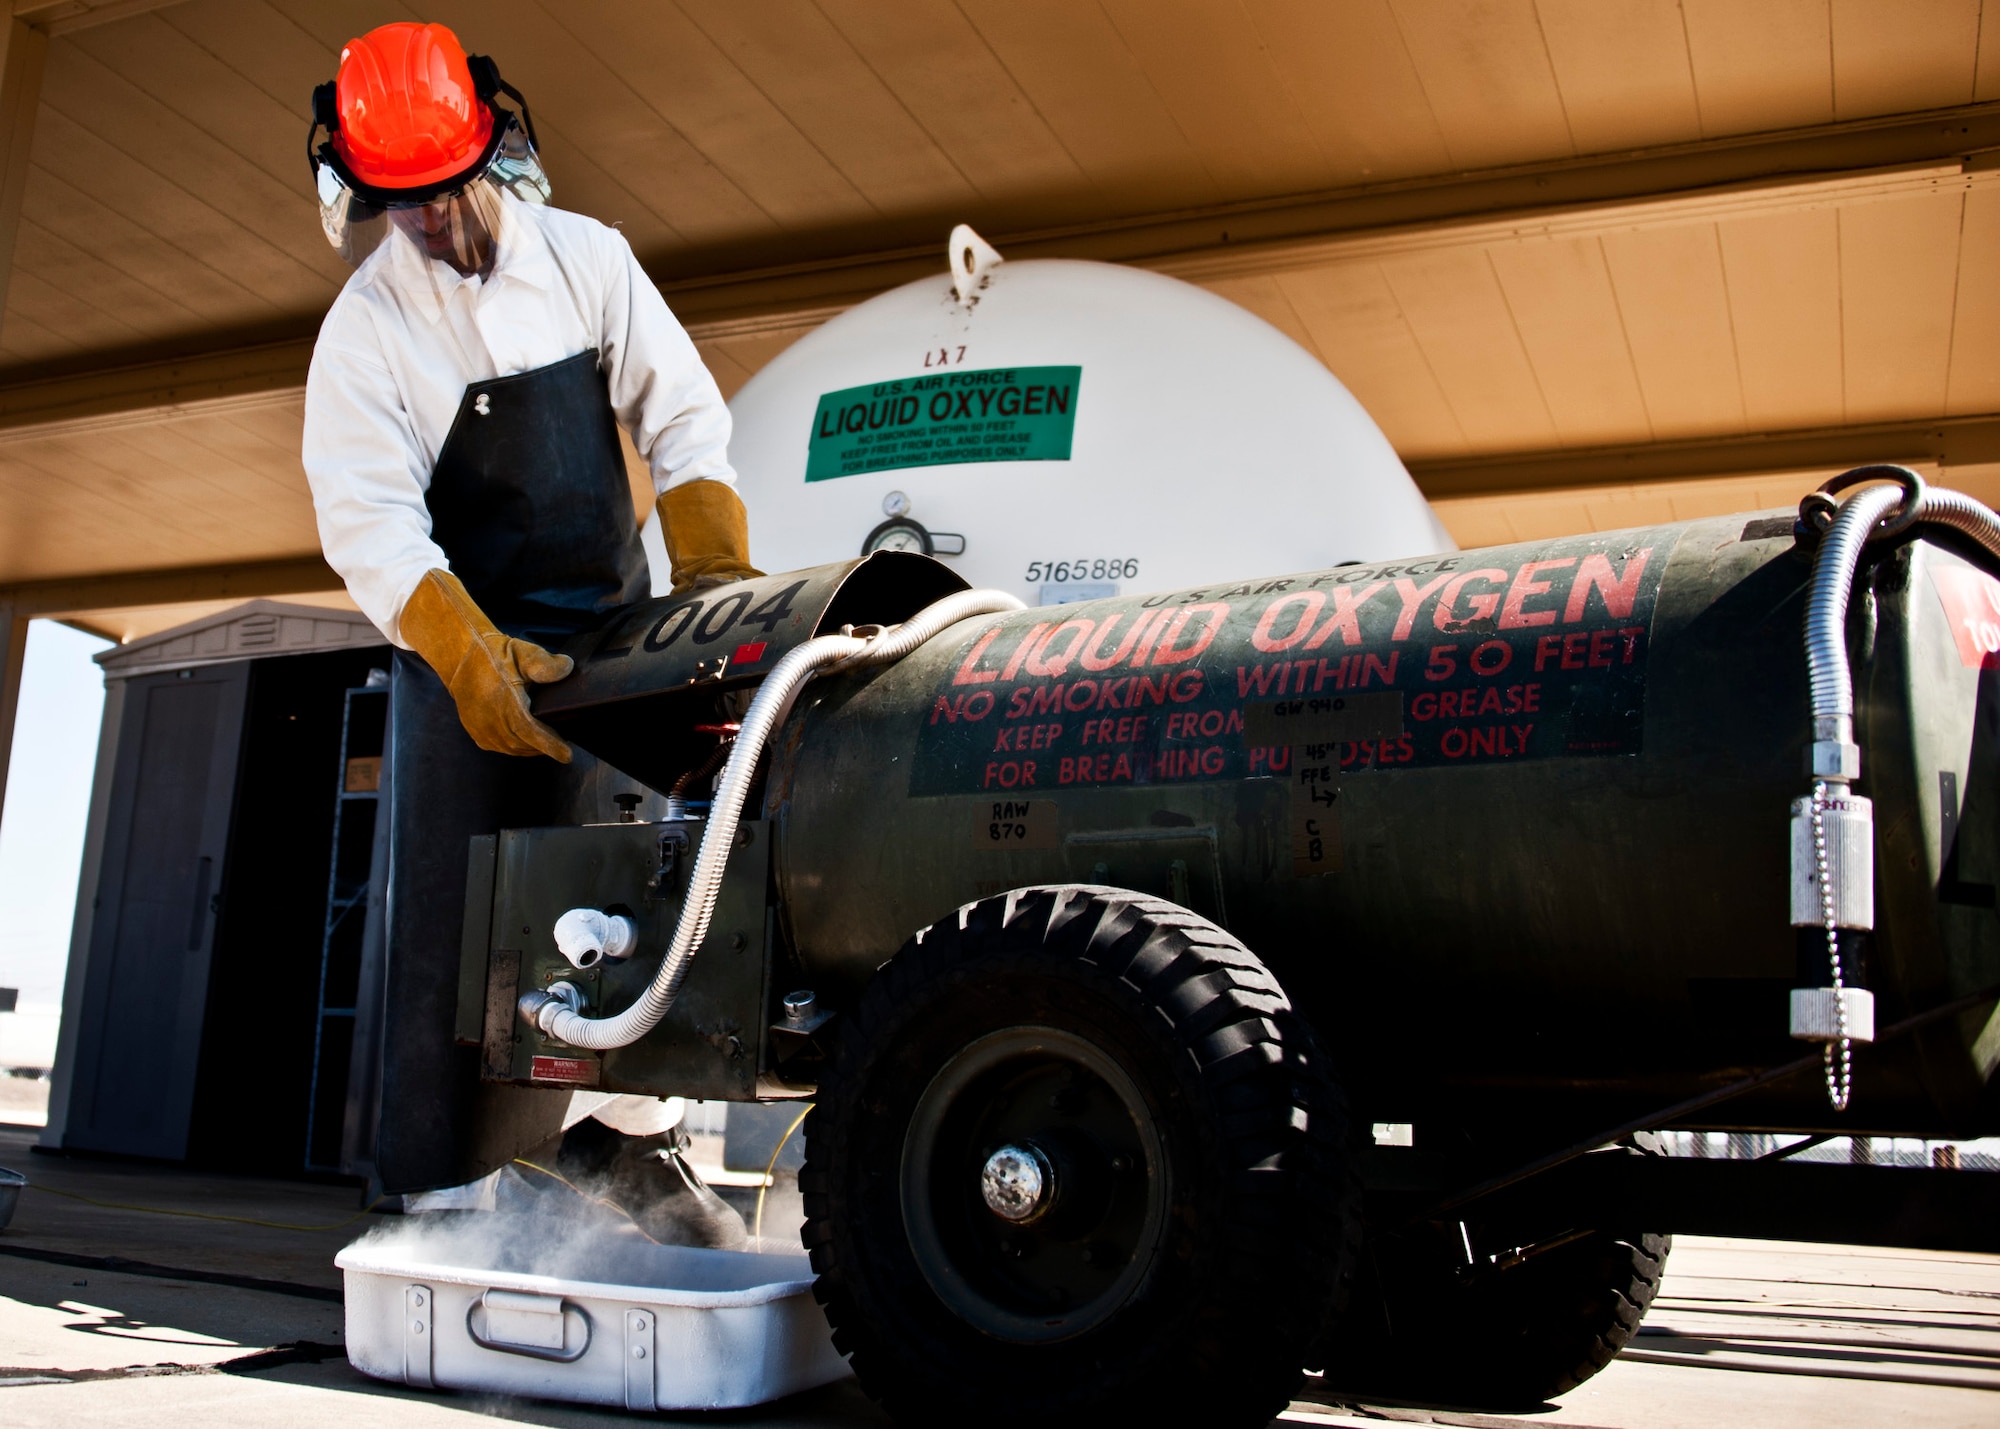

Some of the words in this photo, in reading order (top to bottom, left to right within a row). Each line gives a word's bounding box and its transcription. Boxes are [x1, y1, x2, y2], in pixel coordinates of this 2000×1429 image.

[873, 383, 906, 398] U.S.
[912, 376, 945, 392] AIR
[949, 370, 1017, 387] FORCE
[819, 396, 919, 439] LIQUID
[929, 385, 1071, 421] OXYGEN
[857, 434, 873, 445] NO
[876, 427, 926, 443] SMOKING
[929, 423, 968, 435] WITHIN
[986, 420, 1016, 431] FEET
[840, 447, 869, 460] KEEP
[871, 443, 899, 456] FREE
[902, 439, 933, 450] FROM
[936, 437, 953, 448] OIL
[956, 434, 981, 445] AND
[983, 432, 1031, 444] GREASE
[842, 461, 863, 472] FOR
[866, 452, 928, 469] BREATHING
[930, 447, 992, 461] PURPOSES
[994, 446, 1027, 458] ONLY
[1024, 558, 1140, 583] 5165886
[1219, 578, 1296, 600] AIR
[1308, 557, 1464, 588] FORCE
[951, 601, 1231, 687] LIQUID
[1250, 547, 1653, 654] OXYGEN
[930, 690, 995, 726] NO
[1006, 669, 1204, 720] SMOKING
[1237, 650, 1400, 699] WITHIN
[1533, 627, 1645, 673] FEET
[1274, 701, 1304, 717] GW
[1308, 698, 1346, 714] 940
[1412, 683, 1541, 722] GREASE
[994, 724, 1063, 753] KEEP
[1082, 715, 1149, 746] FREE
[984, 761, 1037, 789] FOR
[1059, 747, 1225, 785] BREATHING
[1440, 724, 1534, 759] ONLY
[1301, 765, 1331, 785] FFE
[992, 801, 1030, 820] RAW
[989, 823, 1026, 840] 870
[1305, 819, 1321, 836] C
[1308, 837, 1324, 862] B
[554, 1060, 578, 1068] WARNING
